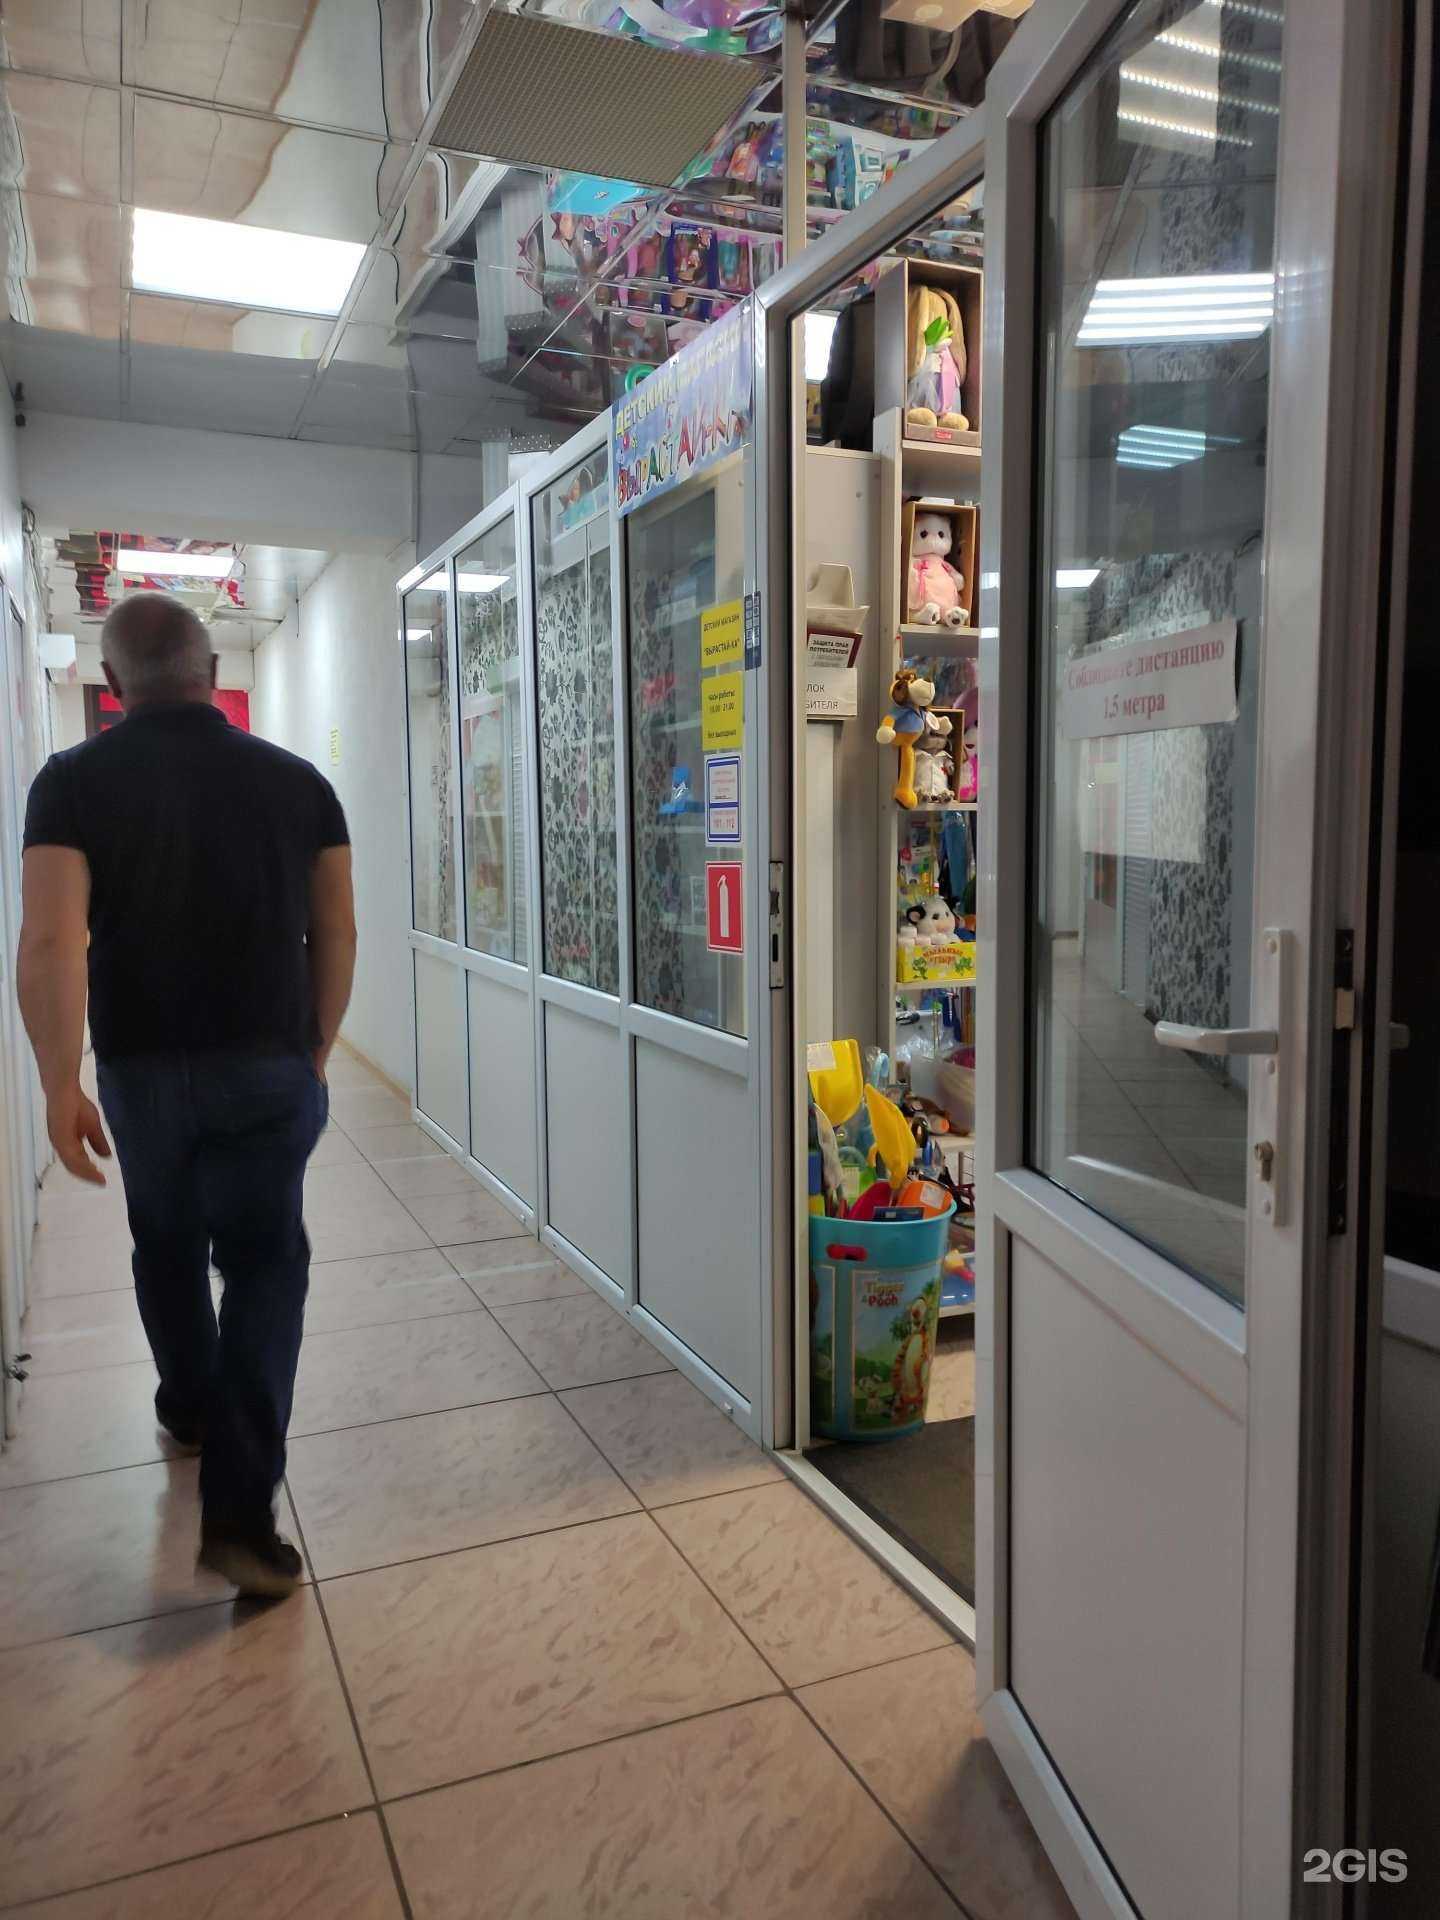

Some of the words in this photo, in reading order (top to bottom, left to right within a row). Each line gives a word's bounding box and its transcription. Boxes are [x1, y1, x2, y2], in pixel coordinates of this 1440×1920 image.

[1135, 639, 1225, 677] дистанцию
[1122, 693, 1166, 720] метра
[868, 1294, 899, 1308] Pooh
